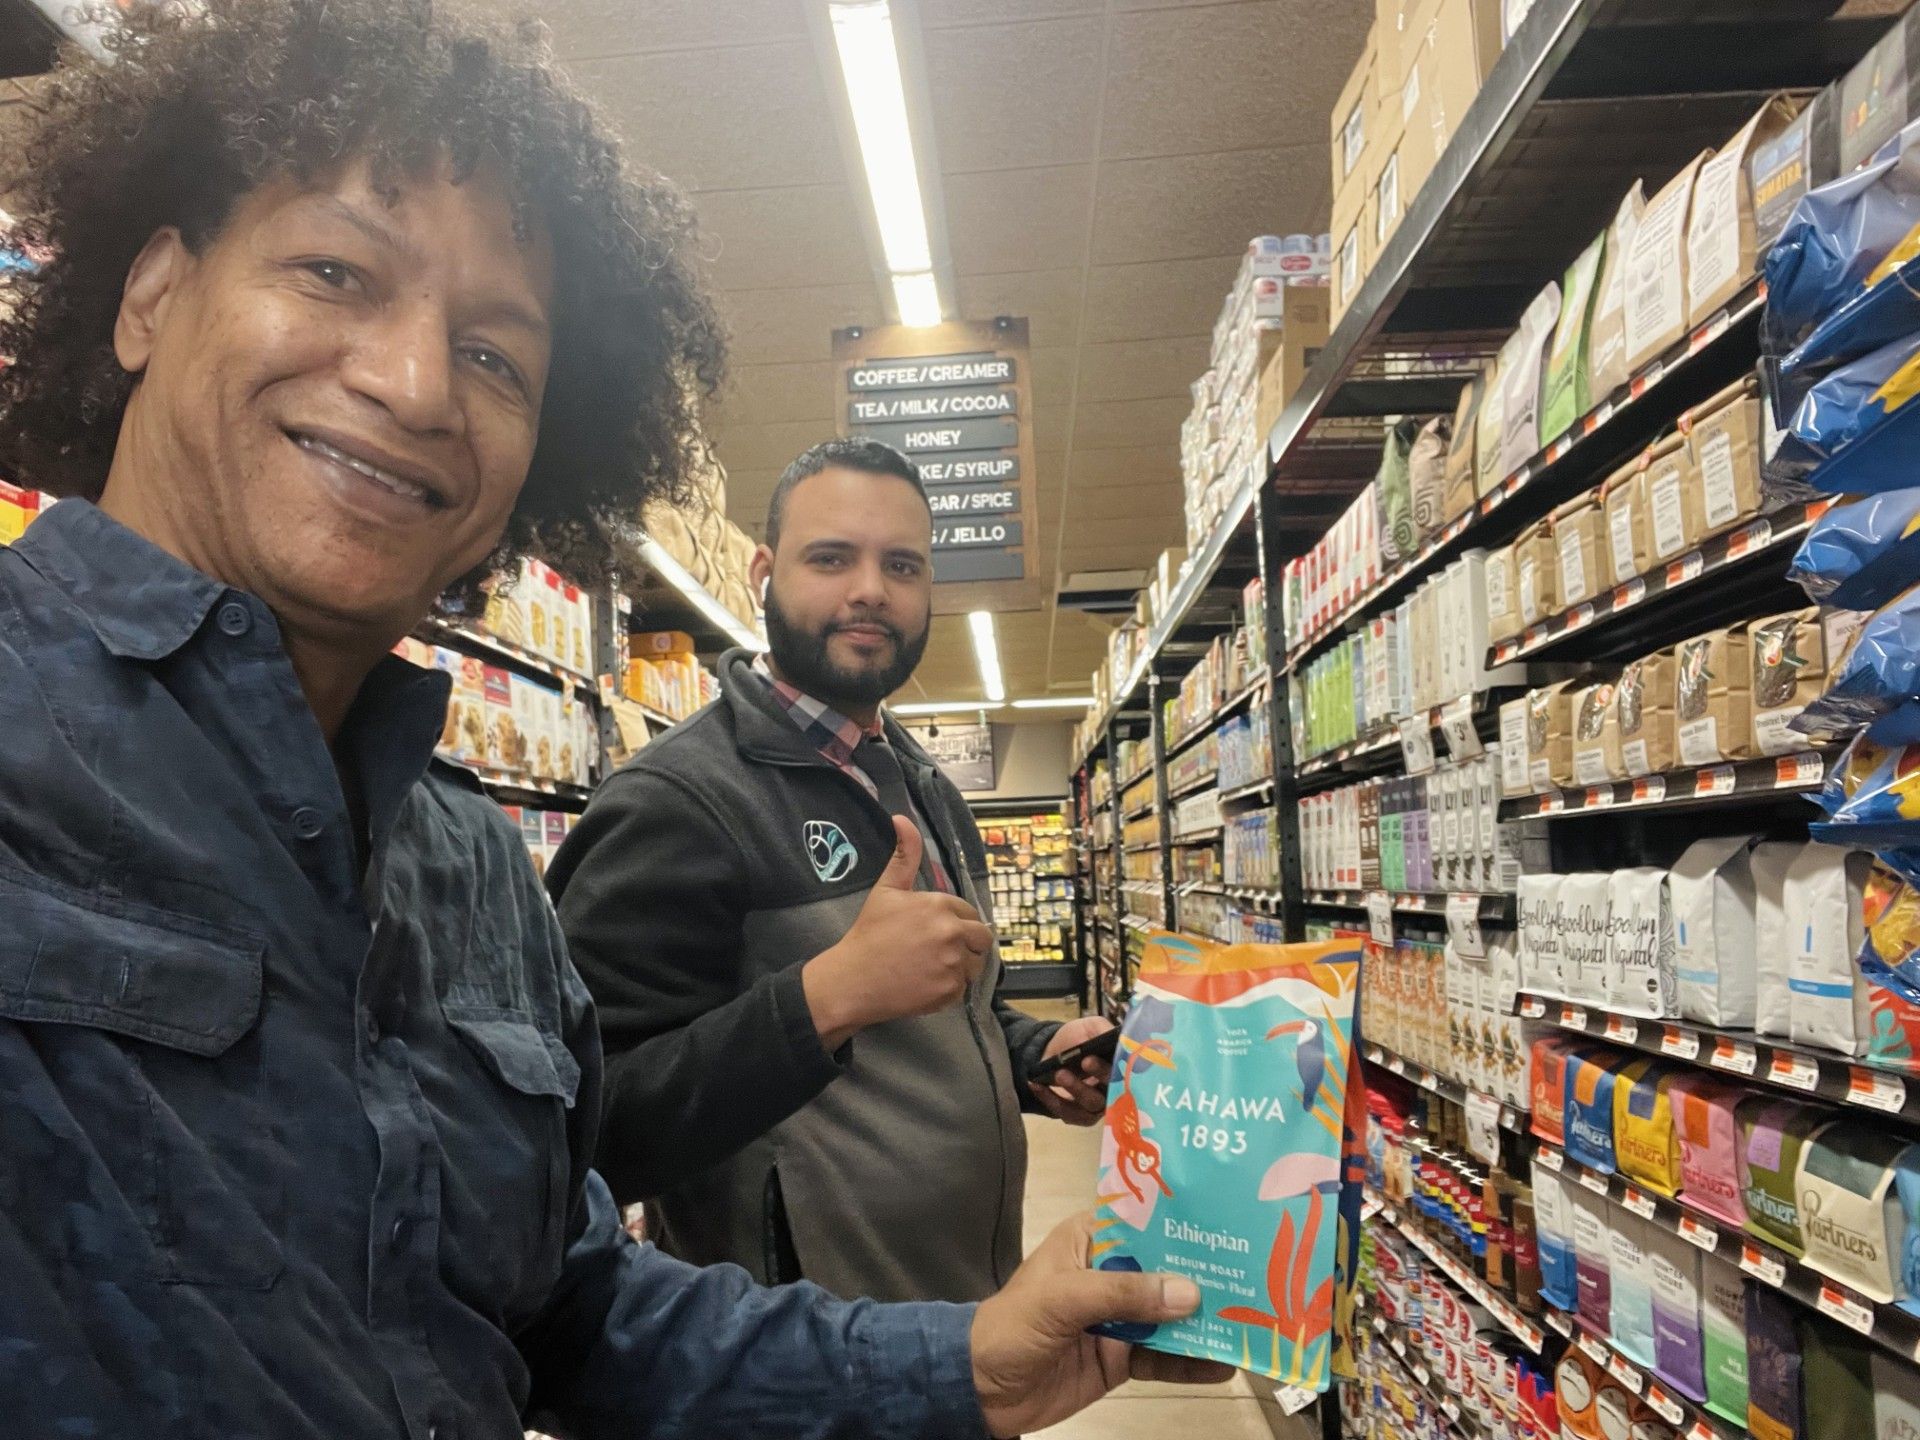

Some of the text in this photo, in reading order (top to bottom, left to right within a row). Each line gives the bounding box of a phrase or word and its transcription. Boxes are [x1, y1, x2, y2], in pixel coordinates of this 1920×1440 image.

[905, 430, 962, 448] HONEY
[1153, 1083, 1287, 1124] KAHAWA
[1180, 1123, 1248, 1155] 1893
[1164, 1217, 1250, 1254] Ethiopian
[1802, 1189, 1877, 1262] Partners
[1165, 1253, 1208, 1272] MEDIUM
[1209, 1262, 1246, 1280] ROAST
